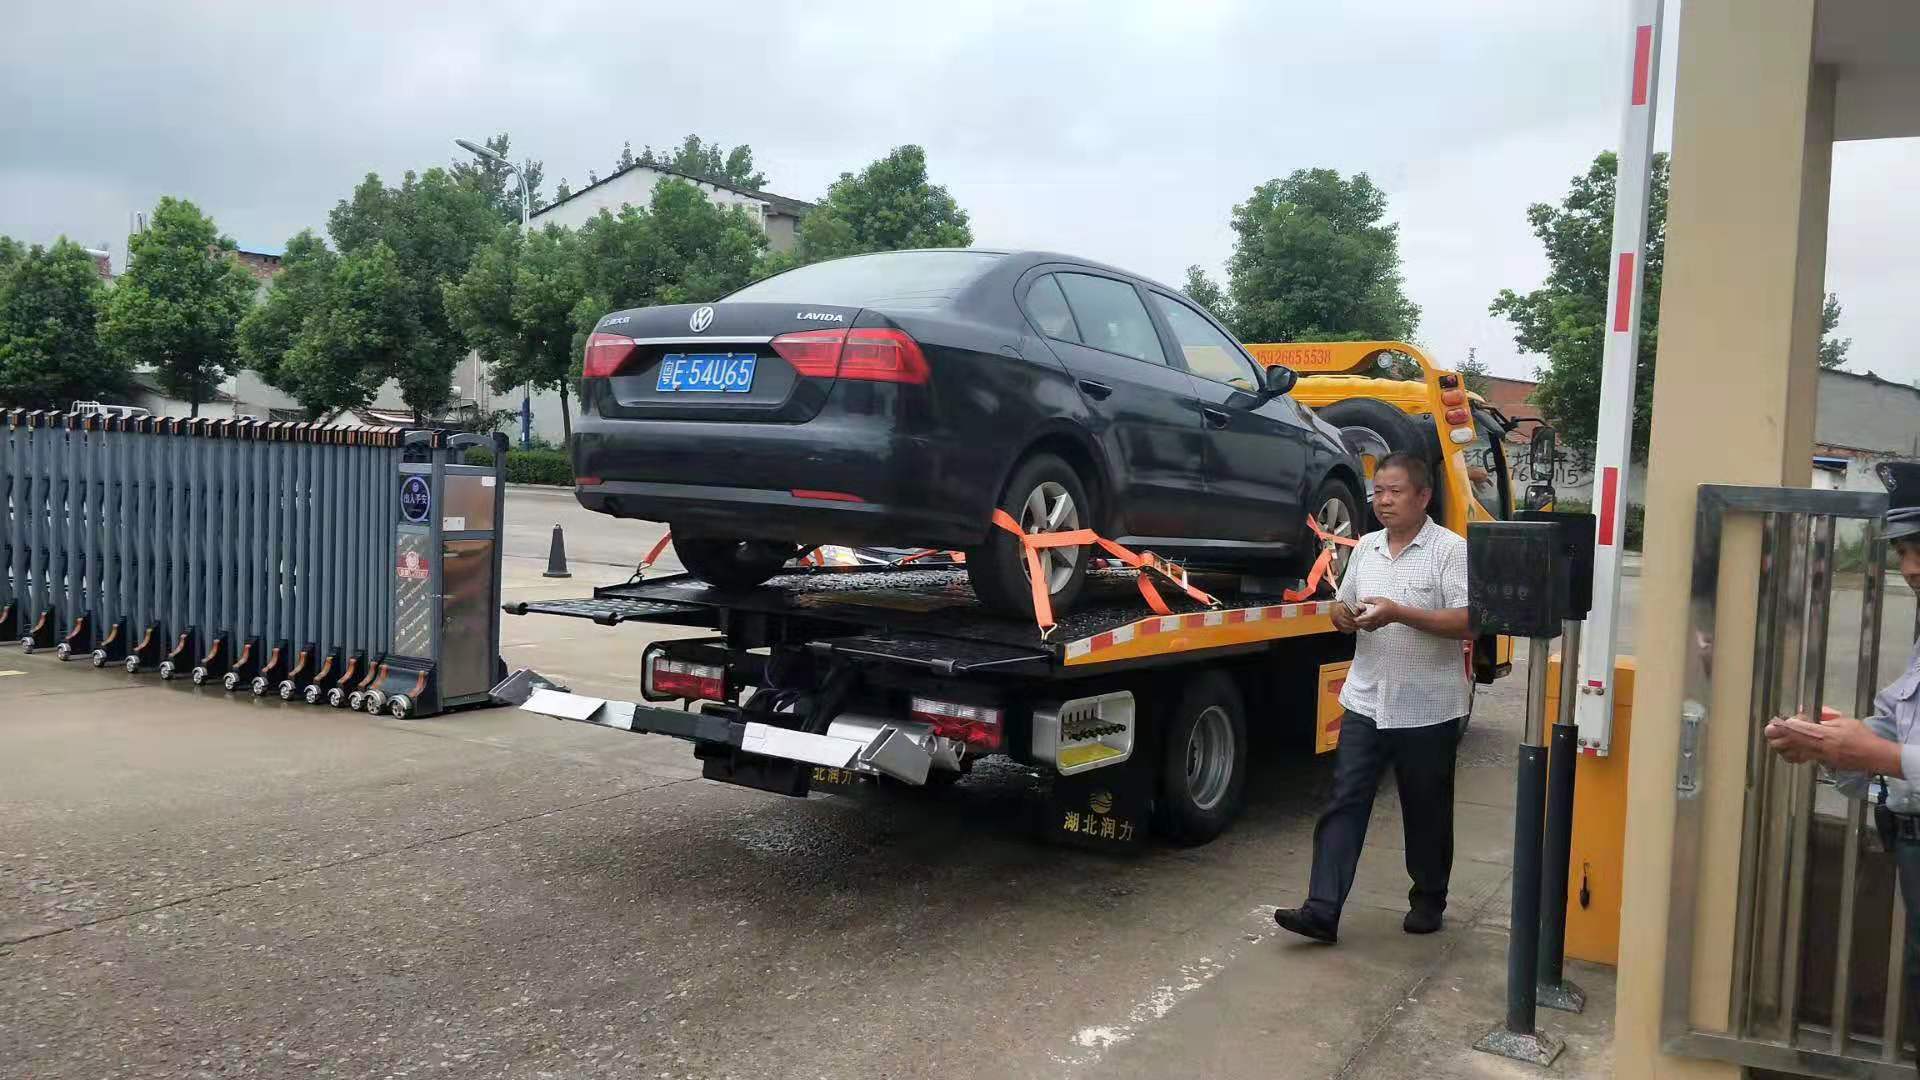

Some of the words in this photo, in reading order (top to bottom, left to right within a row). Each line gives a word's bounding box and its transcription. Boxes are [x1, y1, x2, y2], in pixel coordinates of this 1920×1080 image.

[796, 312, 843, 322] LAVIDA
[812, 767, 852, 785] 北润力
[1063, 810, 1134, 841] 湖北润力
